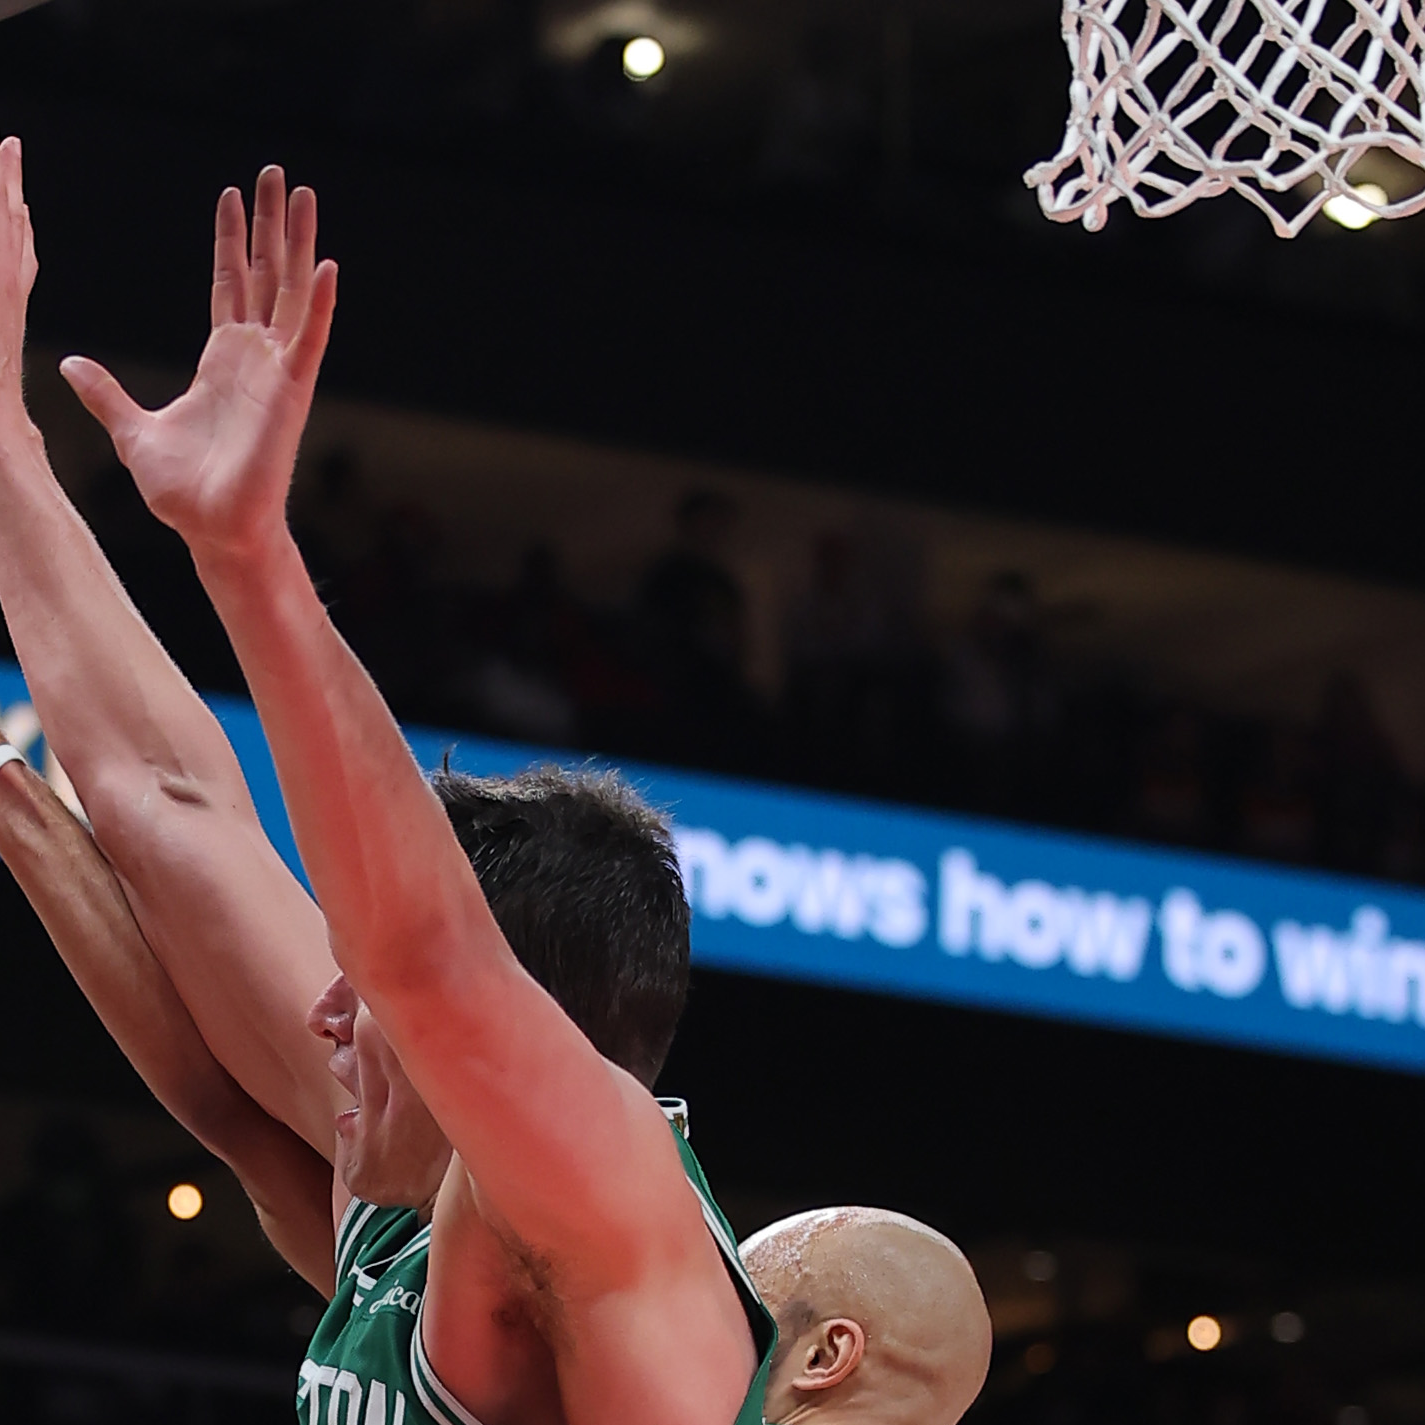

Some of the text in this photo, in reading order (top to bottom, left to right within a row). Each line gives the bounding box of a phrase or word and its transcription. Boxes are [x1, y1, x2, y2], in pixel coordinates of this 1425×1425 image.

[672, 826, 928, 948] nows
[936, 847, 1152, 983] how
[1159, 886, 1269, 999] to
